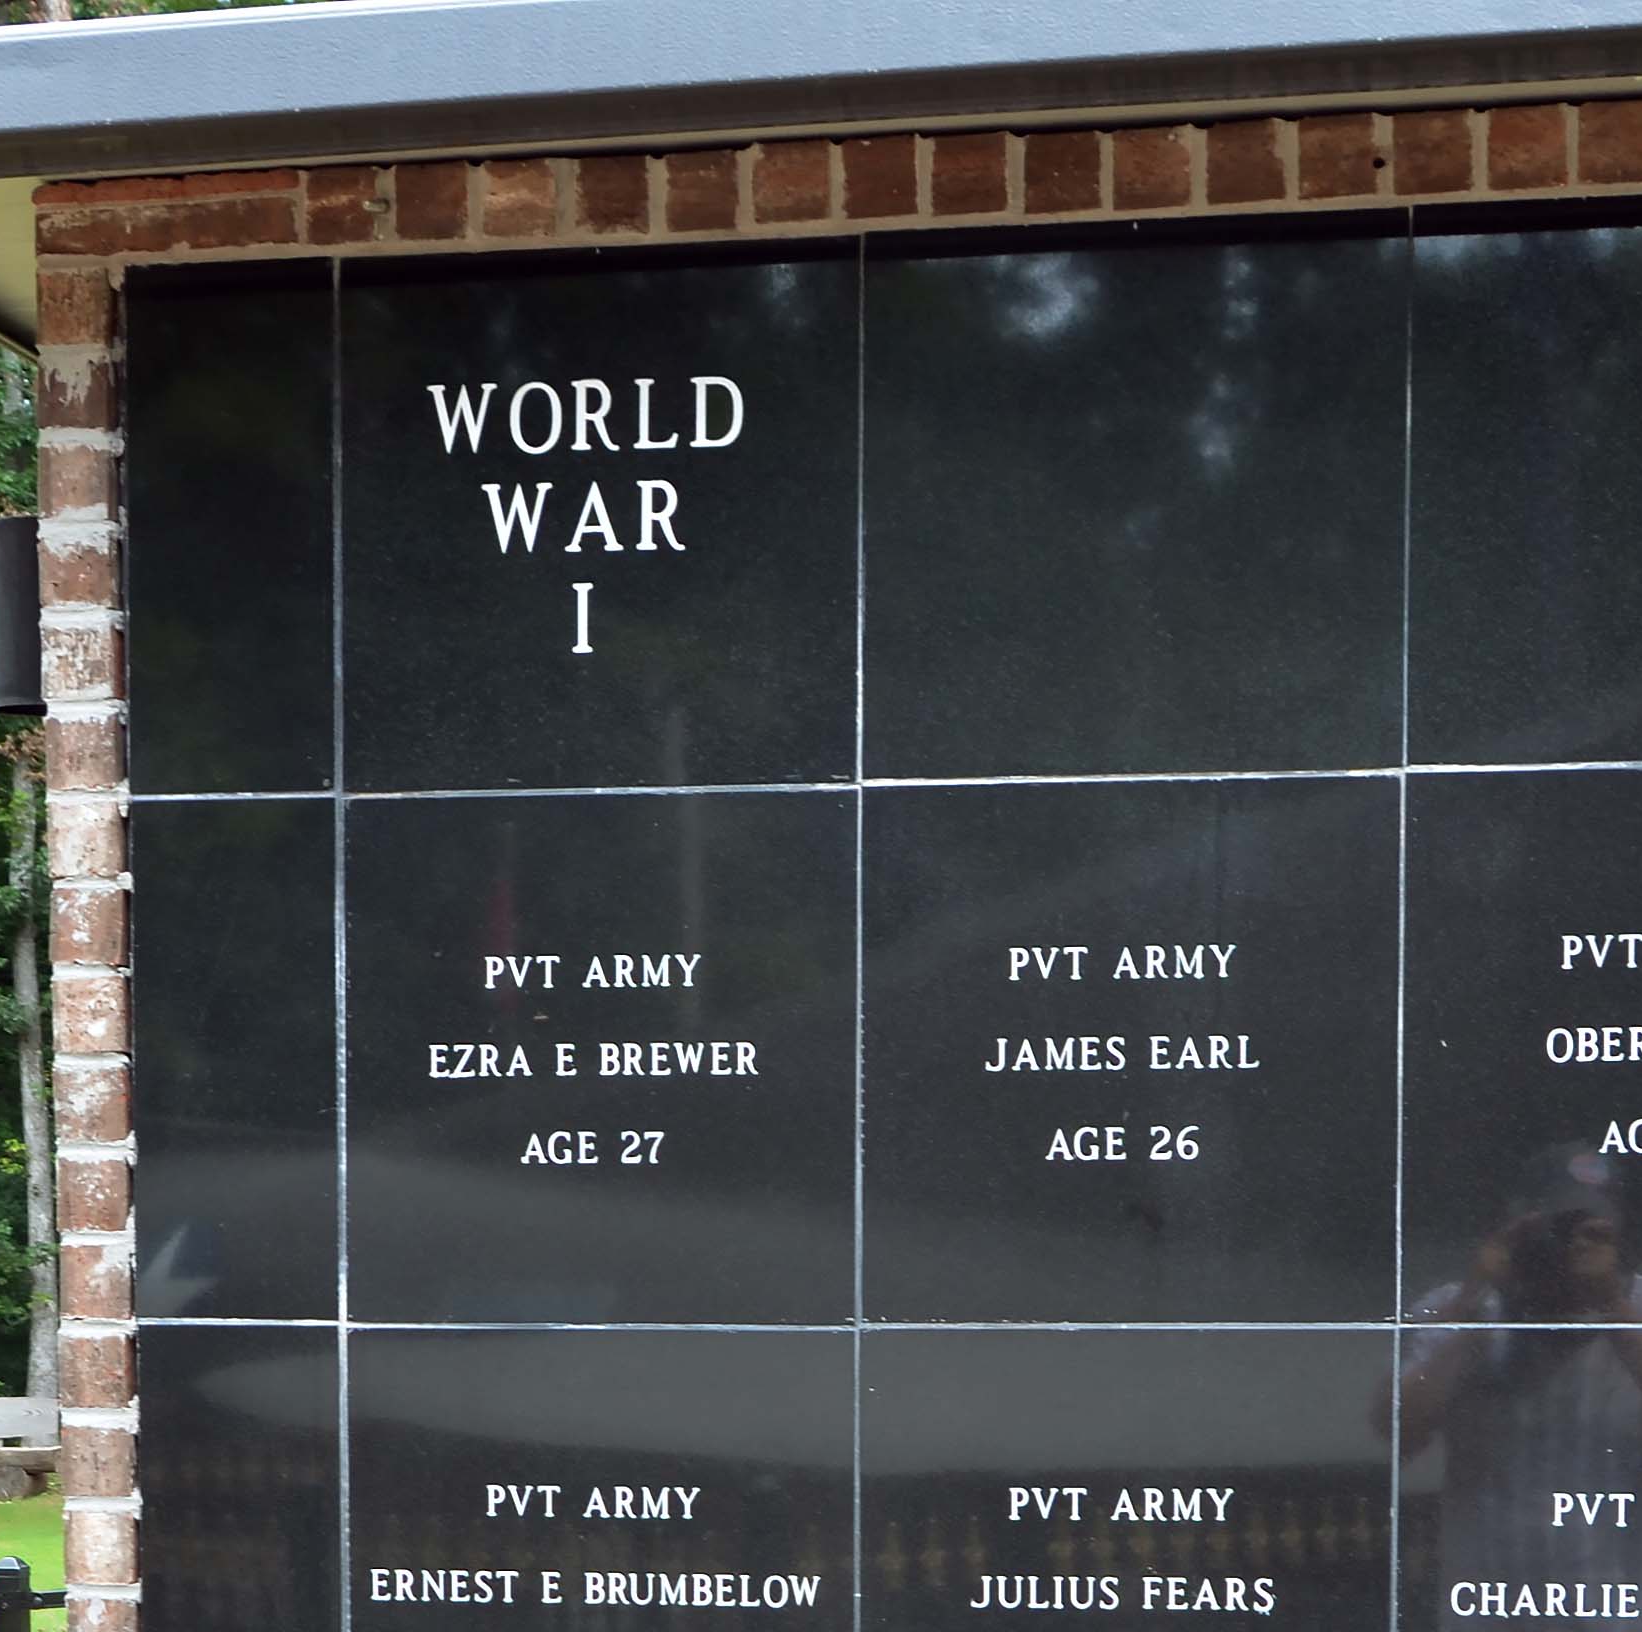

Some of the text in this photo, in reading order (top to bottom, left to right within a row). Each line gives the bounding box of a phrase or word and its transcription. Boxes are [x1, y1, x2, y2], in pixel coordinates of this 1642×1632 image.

[426, 375, 744, 456] WORLD
[480, 478, 687, 555] WAR
[571, 581, 595, 655] I
[483, 952, 703, 991] PVT ARMY
[1008, 943, 1237, 982] PVT ARMY
[428, 1040, 760, 1080] EZRA E BREWER
[984, 1034, 1261, 1073] JAMES EARL
[519, 1129, 666, 1166] AGE 27
[1044, 1124, 1200, 1162] AGE 26
[485, 1483, 702, 1521] PVT ARMY
[1007, 1486, 1235, 1523] PVT ARMY
[1550, 1491, 1636, 1529] PVT
[369, 1567, 822, 1610] ERNEST E BRUMBELOW
[969, 1574, 1275, 1617] JULIUS FEARS
[1449, 1580, 1641, 1620] CHARLIE
